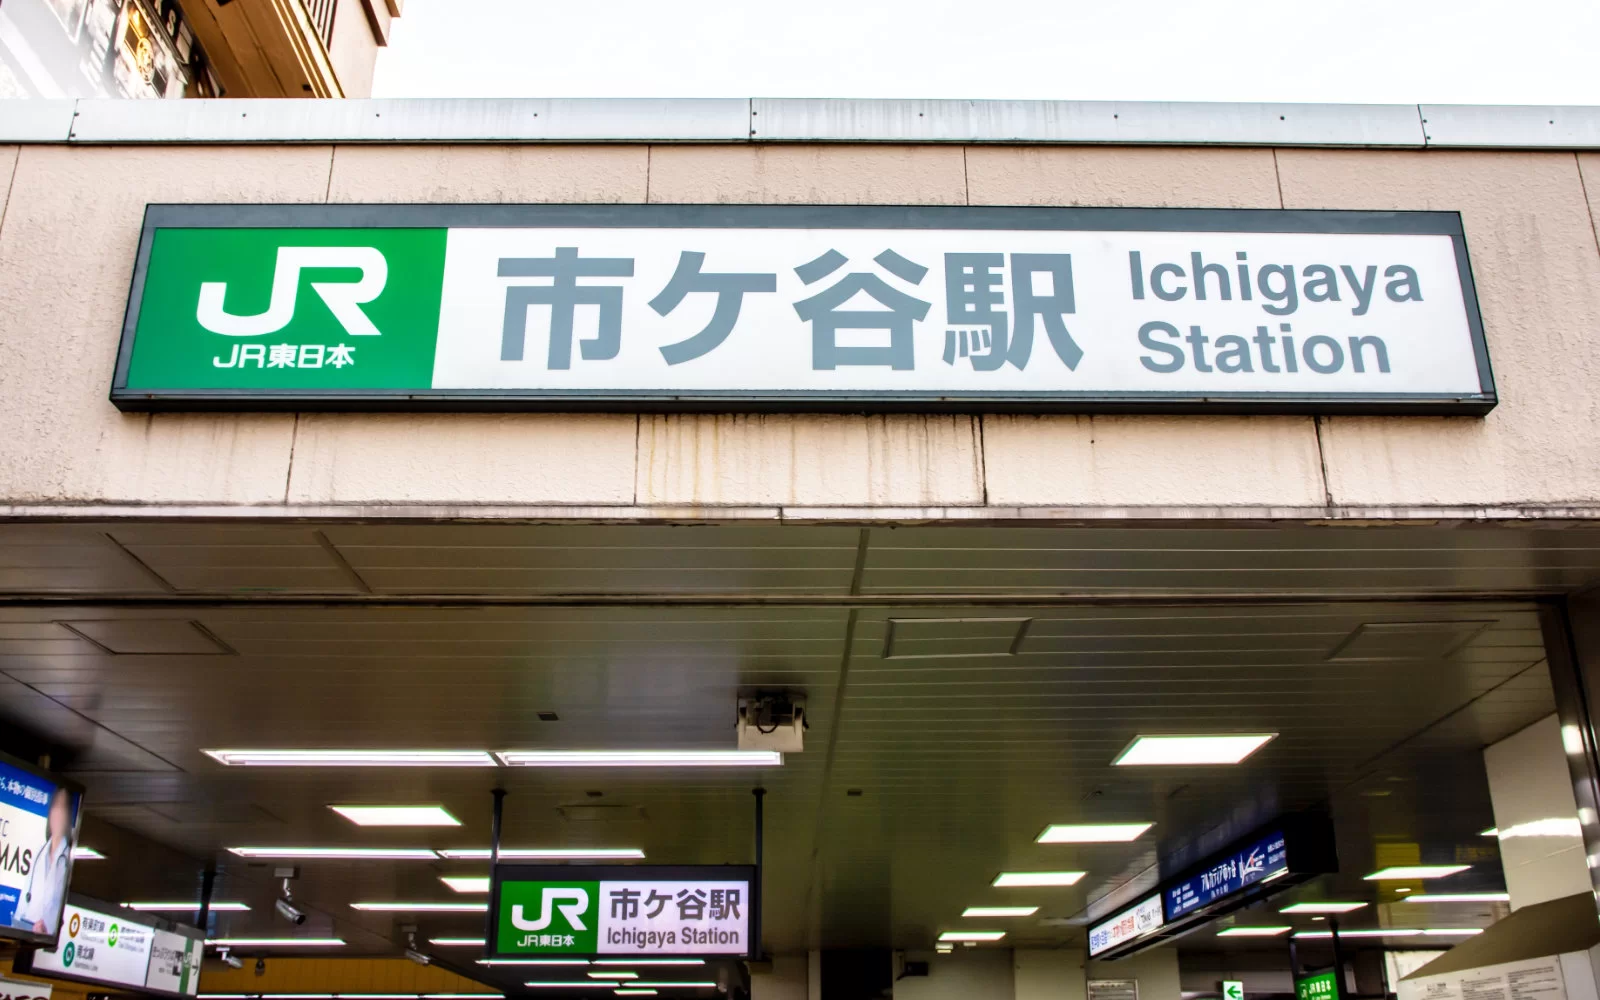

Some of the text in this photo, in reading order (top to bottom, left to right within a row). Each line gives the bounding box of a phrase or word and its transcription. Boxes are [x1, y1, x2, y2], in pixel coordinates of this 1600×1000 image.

[197, 247, 388, 336] JR
[1129, 250, 1424, 316] Ichigaya
[212, 343, 356, 370] JR東日本
[1138, 320, 1391, 374] Station
[511, 887, 589, 931] JR
[517, 934, 575, 947] JR東日本
[608, 926, 739, 949] Ichigaya Station
